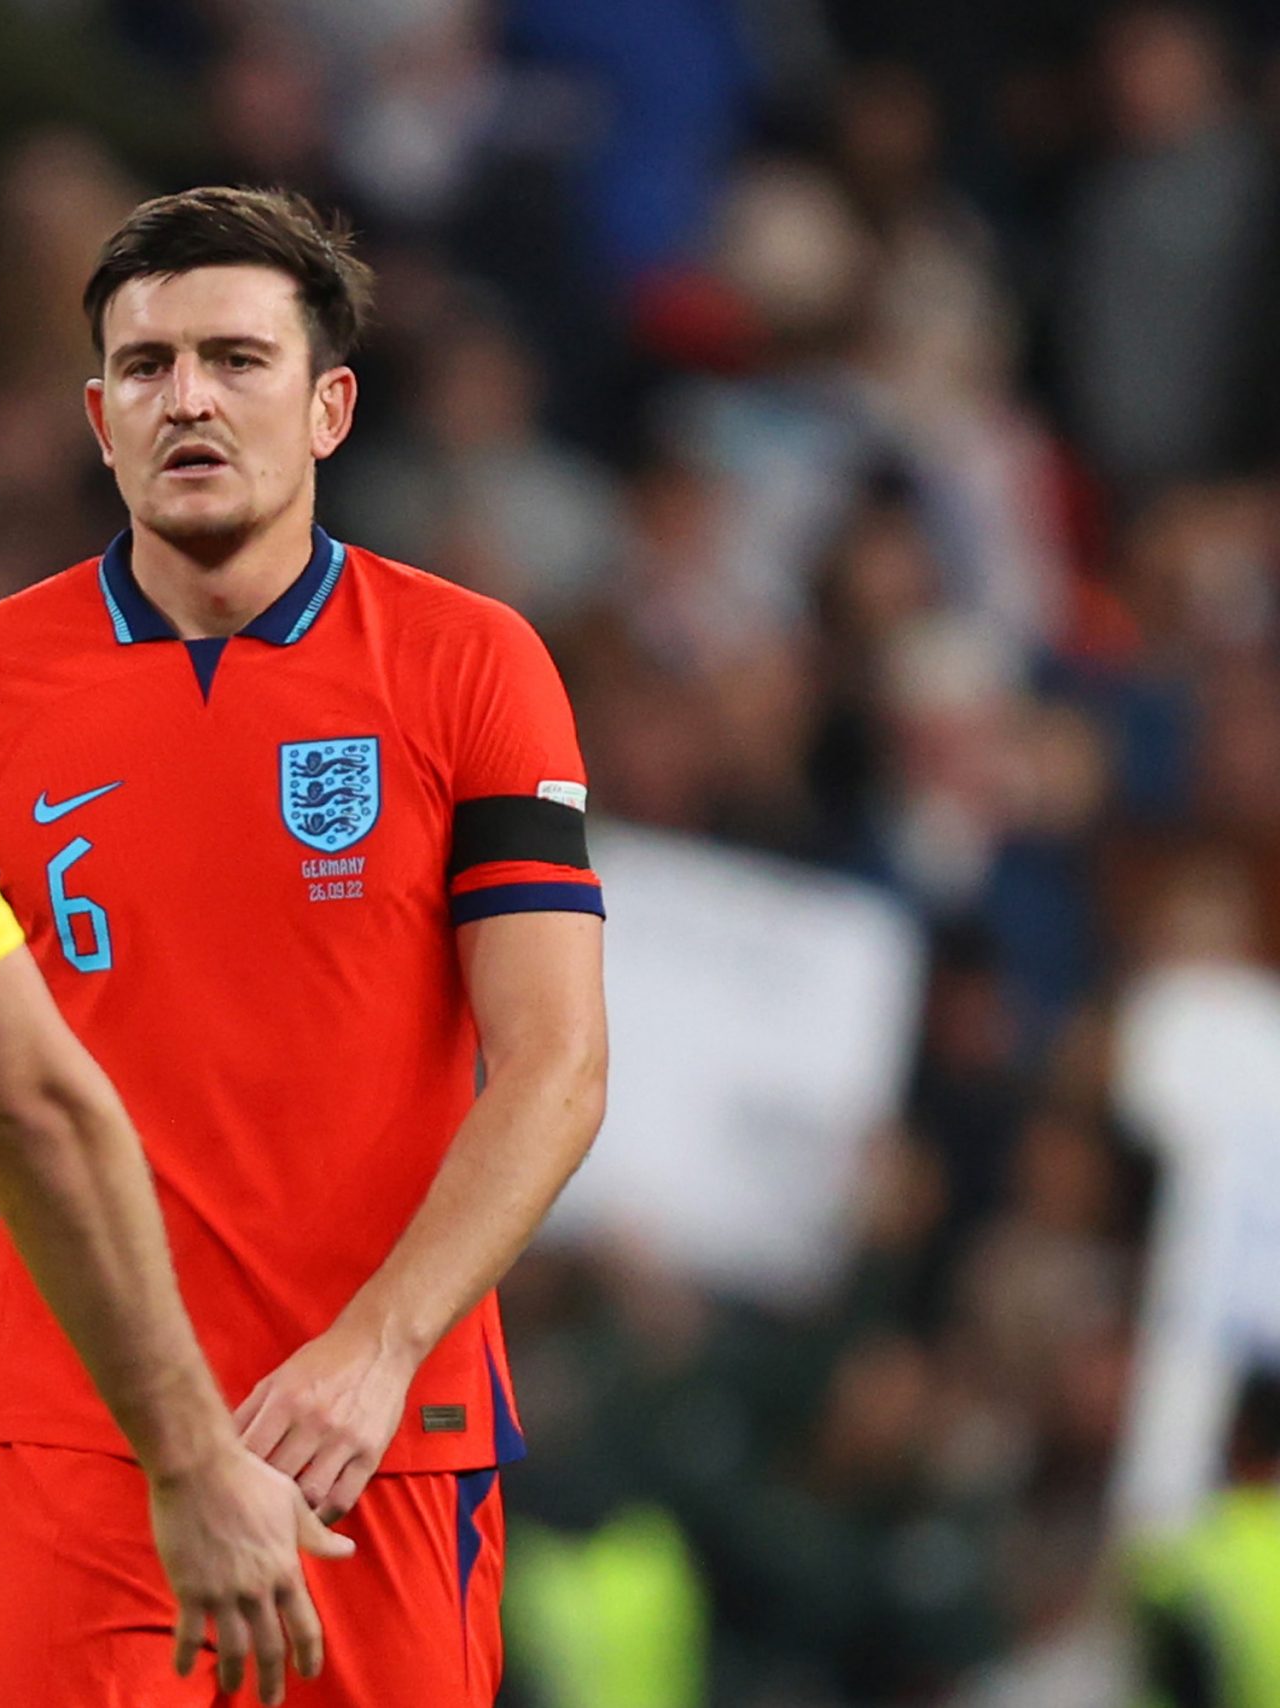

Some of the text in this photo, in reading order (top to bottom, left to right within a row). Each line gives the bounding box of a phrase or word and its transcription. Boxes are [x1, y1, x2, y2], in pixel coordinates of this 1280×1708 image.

[301, 856, 365, 878] GERMANY
[309, 881, 363, 902] 26.09.22
[46, 835, 113, 973] 6
